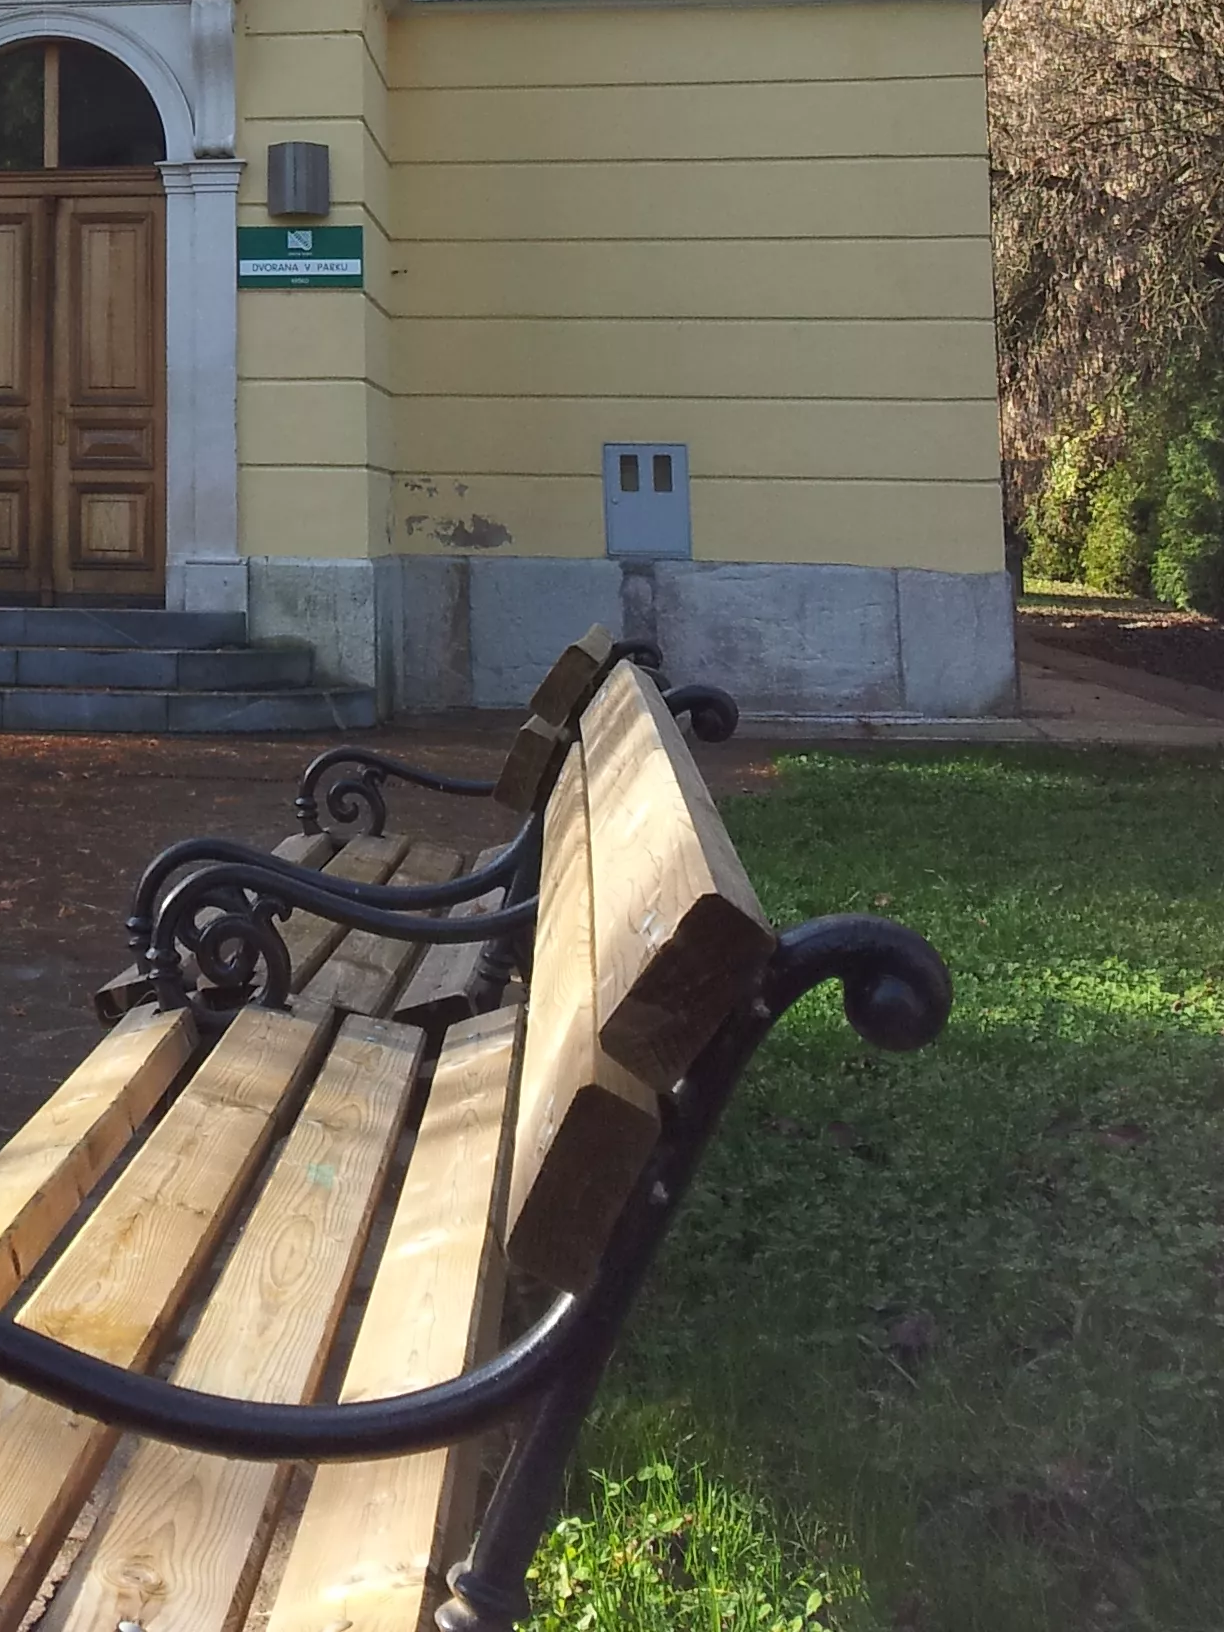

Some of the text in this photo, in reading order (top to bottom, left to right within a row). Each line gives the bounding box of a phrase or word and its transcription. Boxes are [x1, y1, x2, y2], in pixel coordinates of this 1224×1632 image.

[252, 263, 349, 272] DVORANA V PARKU
